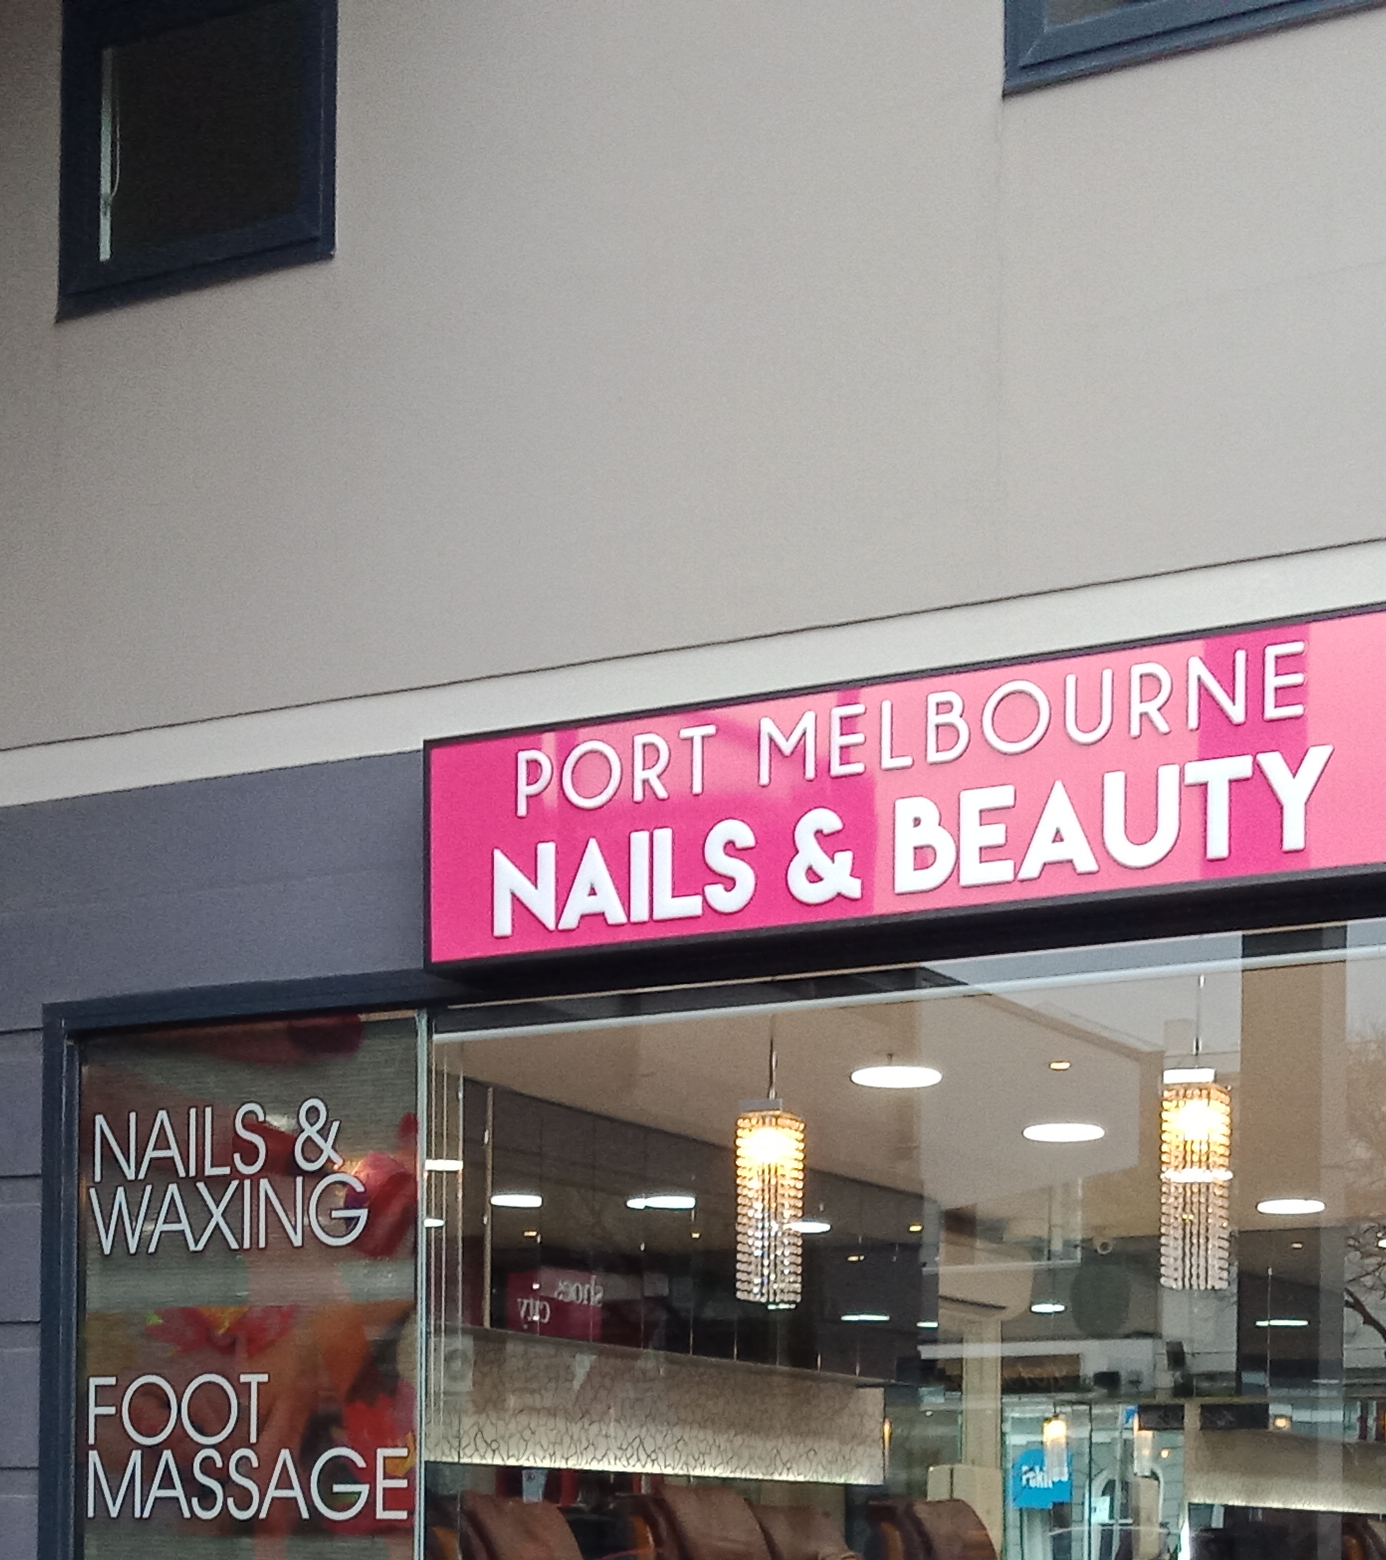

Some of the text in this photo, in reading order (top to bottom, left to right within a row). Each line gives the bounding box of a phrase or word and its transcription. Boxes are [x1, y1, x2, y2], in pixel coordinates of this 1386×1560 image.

[515, 640, 1307, 817] PORT MELBOURNE
[492, 744, 1334, 939] NAILS & BEAUTY
[93, 1096, 344, 1183] NAILS &
[89, 1173, 370, 1257] WAXING
[87, 1372, 270, 1446] FOOT
[87, 1446, 410, 1520] MASSAGE
